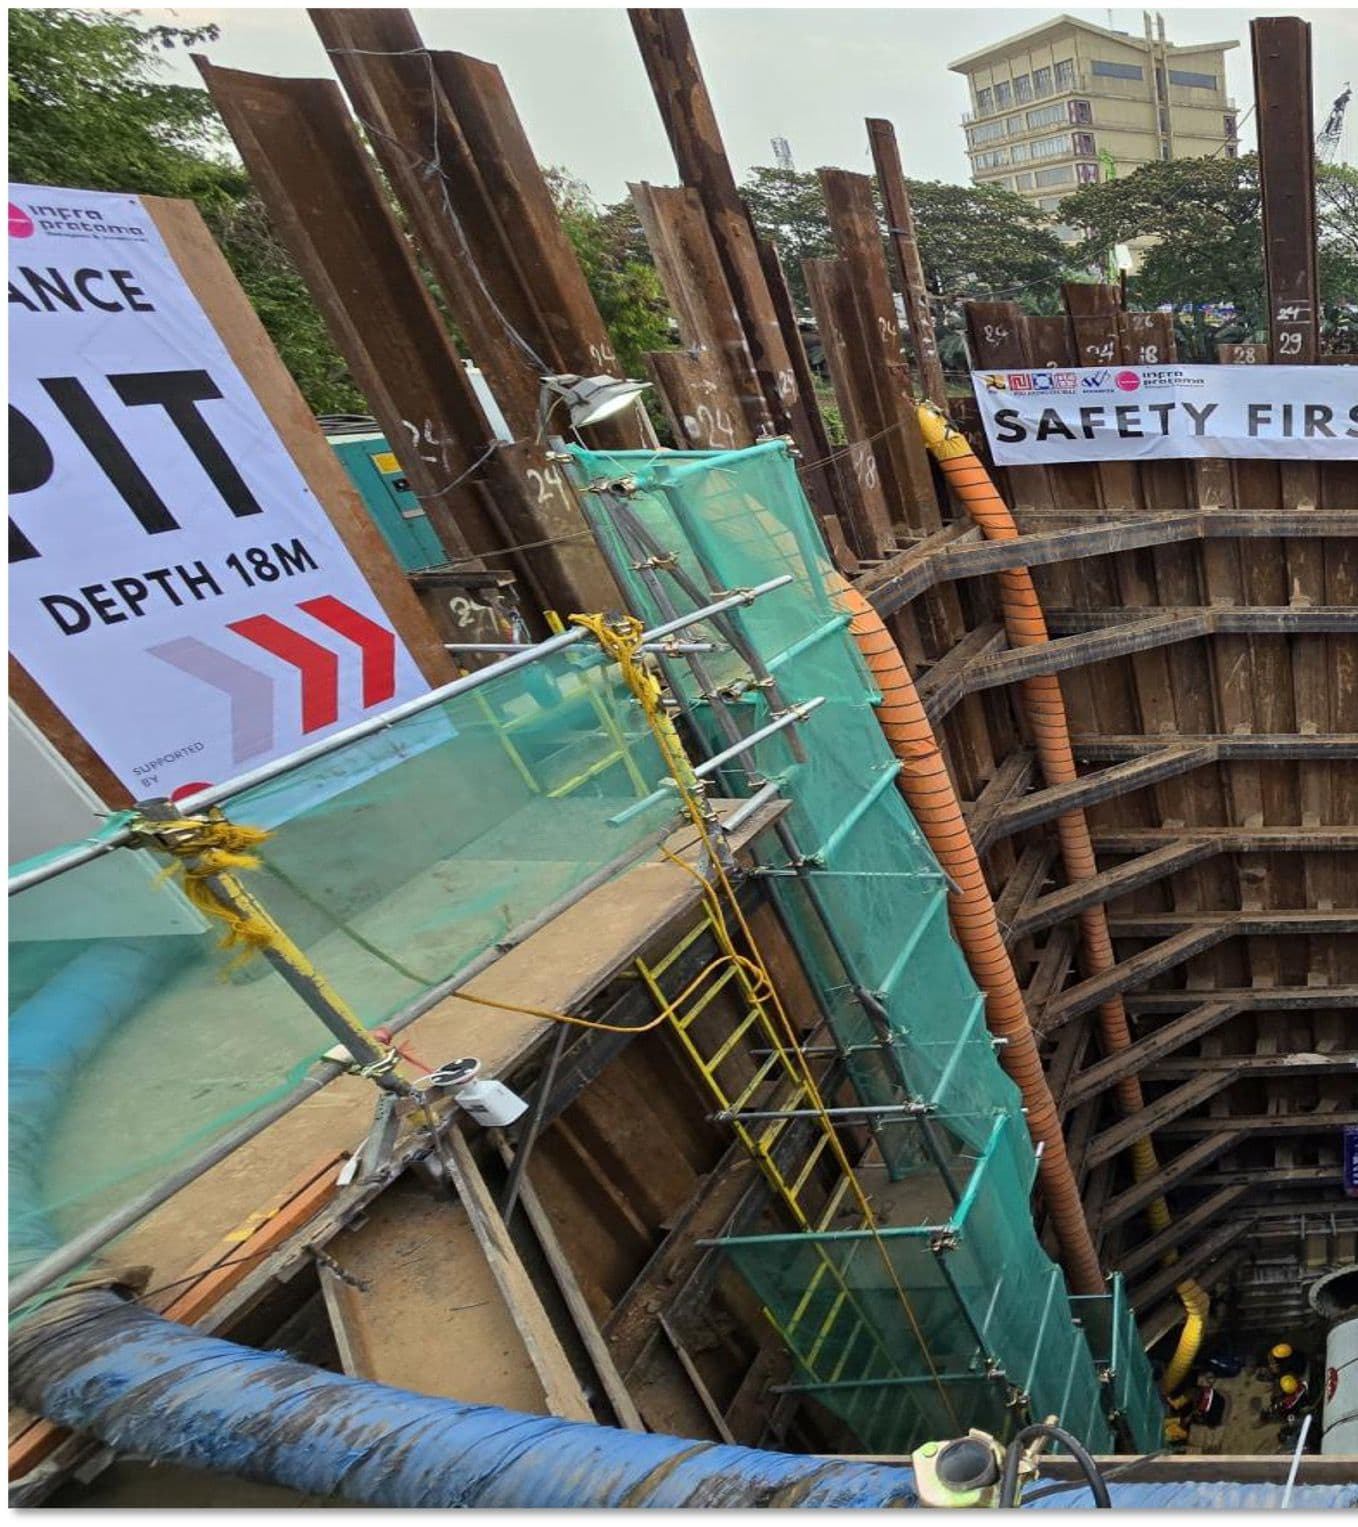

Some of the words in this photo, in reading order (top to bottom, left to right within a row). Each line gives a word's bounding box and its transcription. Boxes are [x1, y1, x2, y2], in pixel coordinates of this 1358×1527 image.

[1280, 333, 1302, 354] 29
[995, 402, 1218, 443] SAFETY
[527, 469, 570, 511] 24
[40, 561, 222, 636] DEPTH
[226, 538, 319, 591] 18M
[132, 742, 205, 776] SUPPORTED
[140, 775, 159, 788] BY
